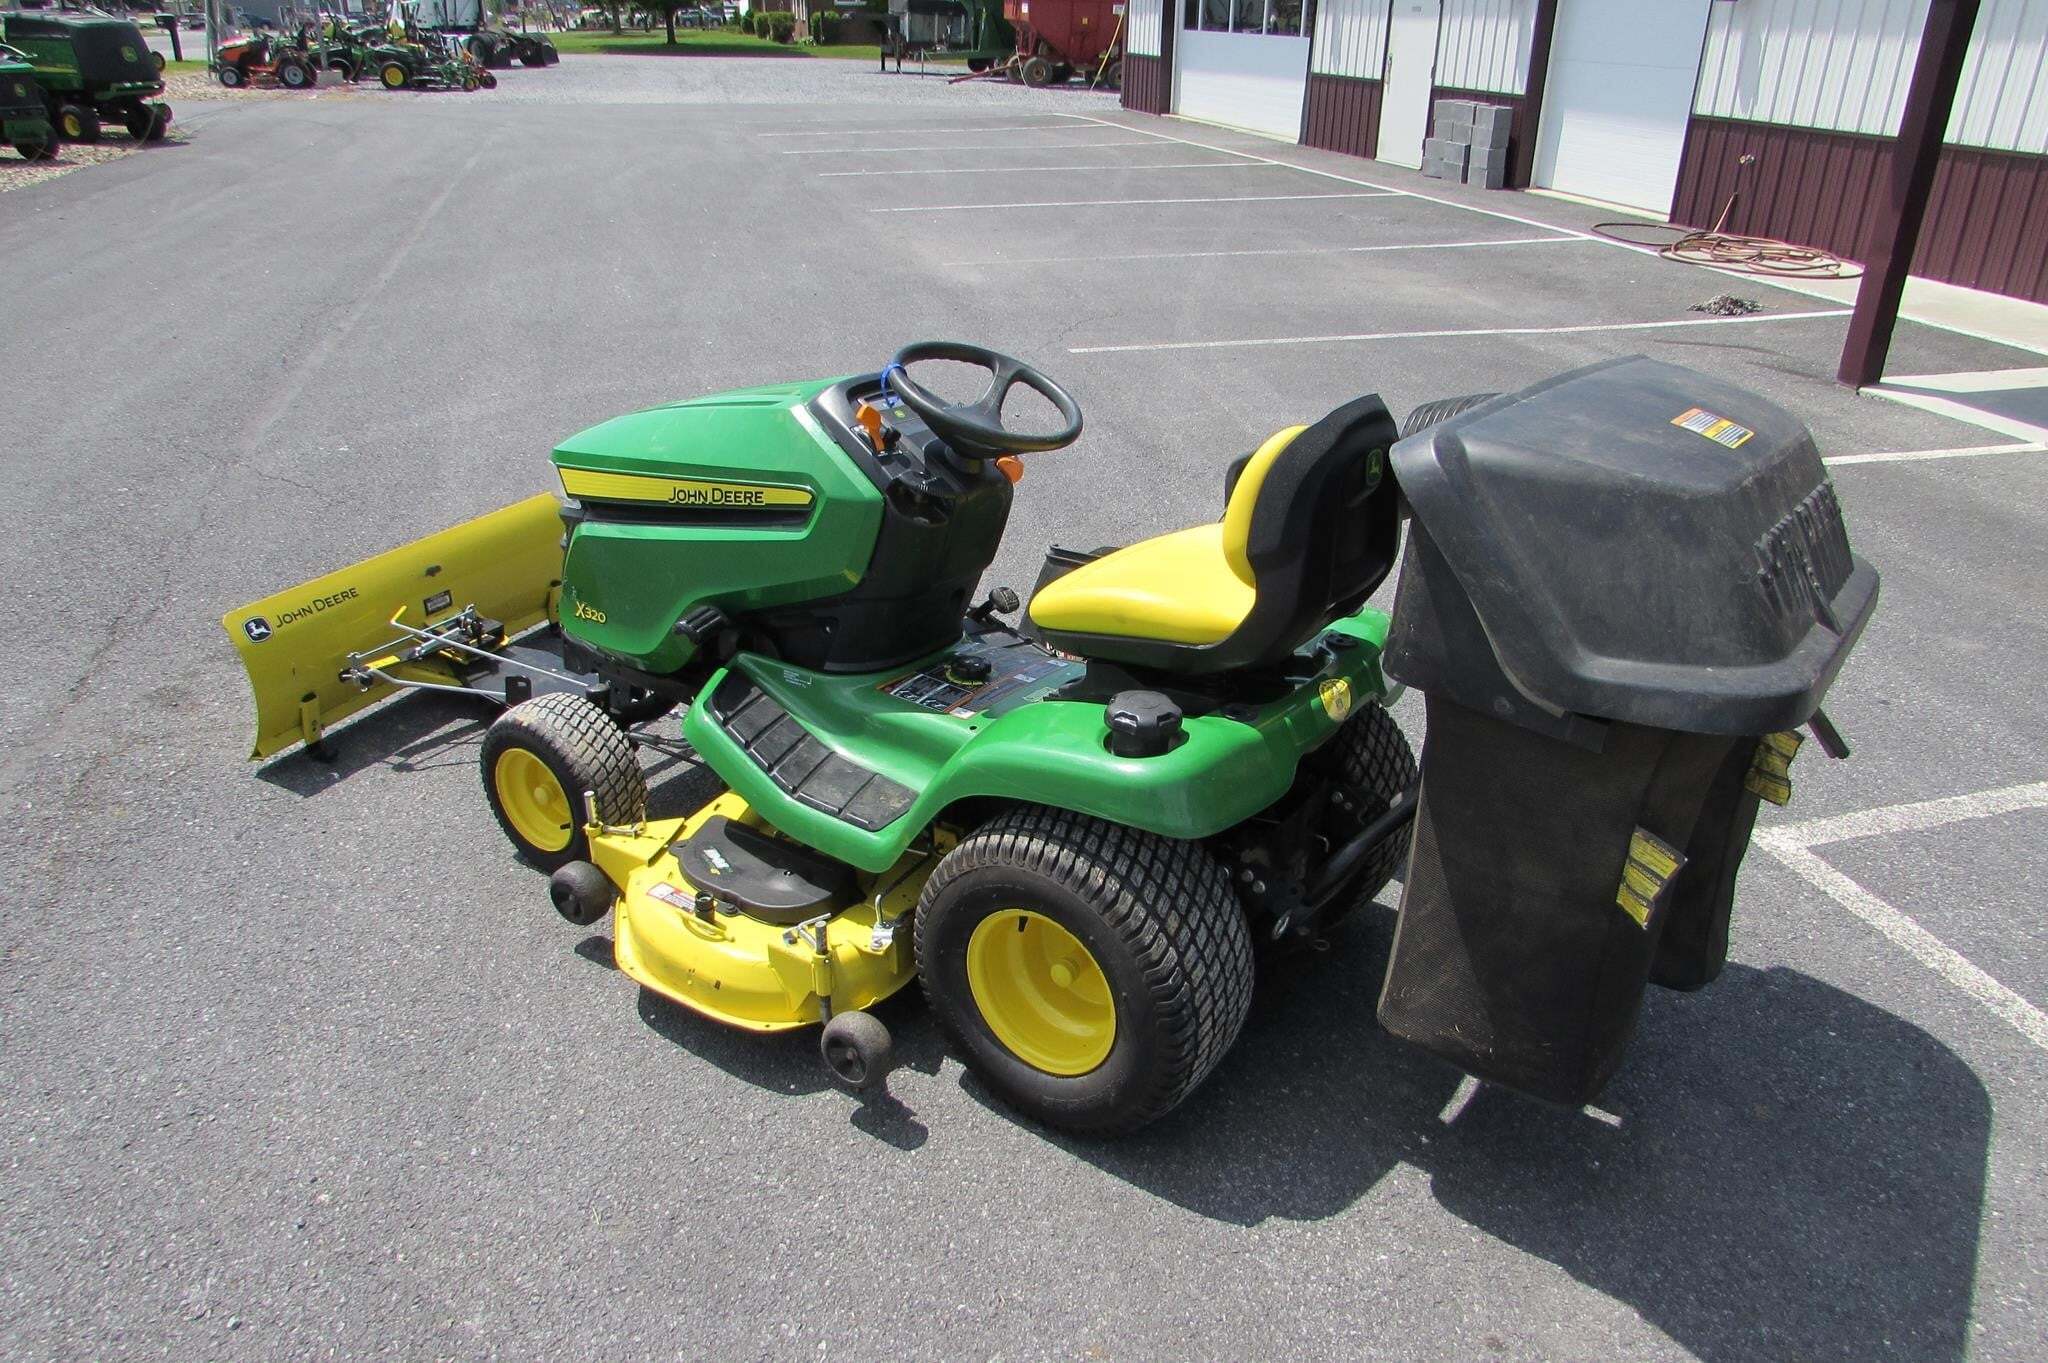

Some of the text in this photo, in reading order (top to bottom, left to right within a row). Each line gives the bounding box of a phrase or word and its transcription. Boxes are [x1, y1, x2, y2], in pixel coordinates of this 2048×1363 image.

[668, 487, 765, 504] JOHN DEERE
[275, 587, 360, 628] JOHN DEERE
[575, 600, 607, 624] X320
